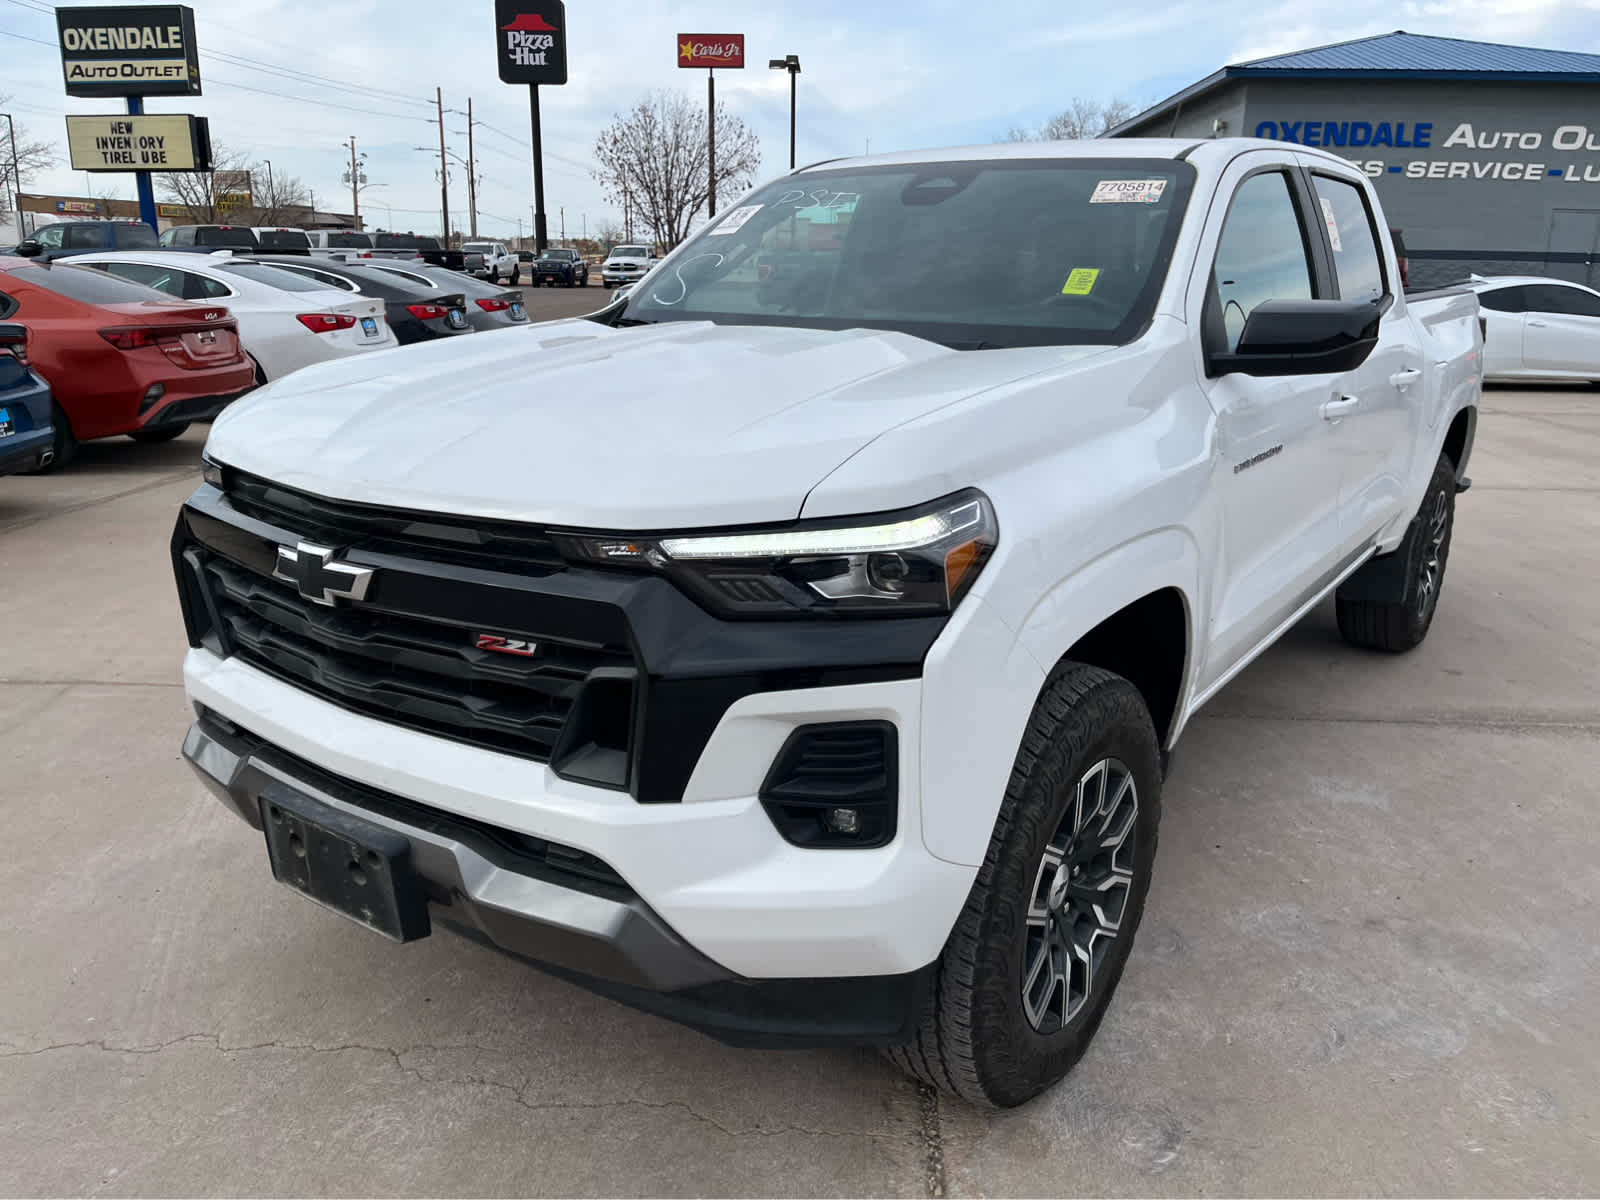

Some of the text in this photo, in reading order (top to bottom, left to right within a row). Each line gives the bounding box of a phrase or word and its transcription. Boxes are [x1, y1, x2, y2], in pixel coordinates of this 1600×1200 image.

[63, 26, 182, 50] OXENDALE
[507, 30, 554, 50] Pizza
[508, 46, 546, 65] Hut
[693, 43, 723, 57] Carl's
[70, 63, 183, 78] AUTO OUTLET
[111, 121, 133, 135] NEW
[1255, 121, 1433, 148] OXENDALE
[1442, 123, 1542, 149] AUTO
[1099, 182, 1164, 192] 7705814
[476, 634, 537, 656] Z71
